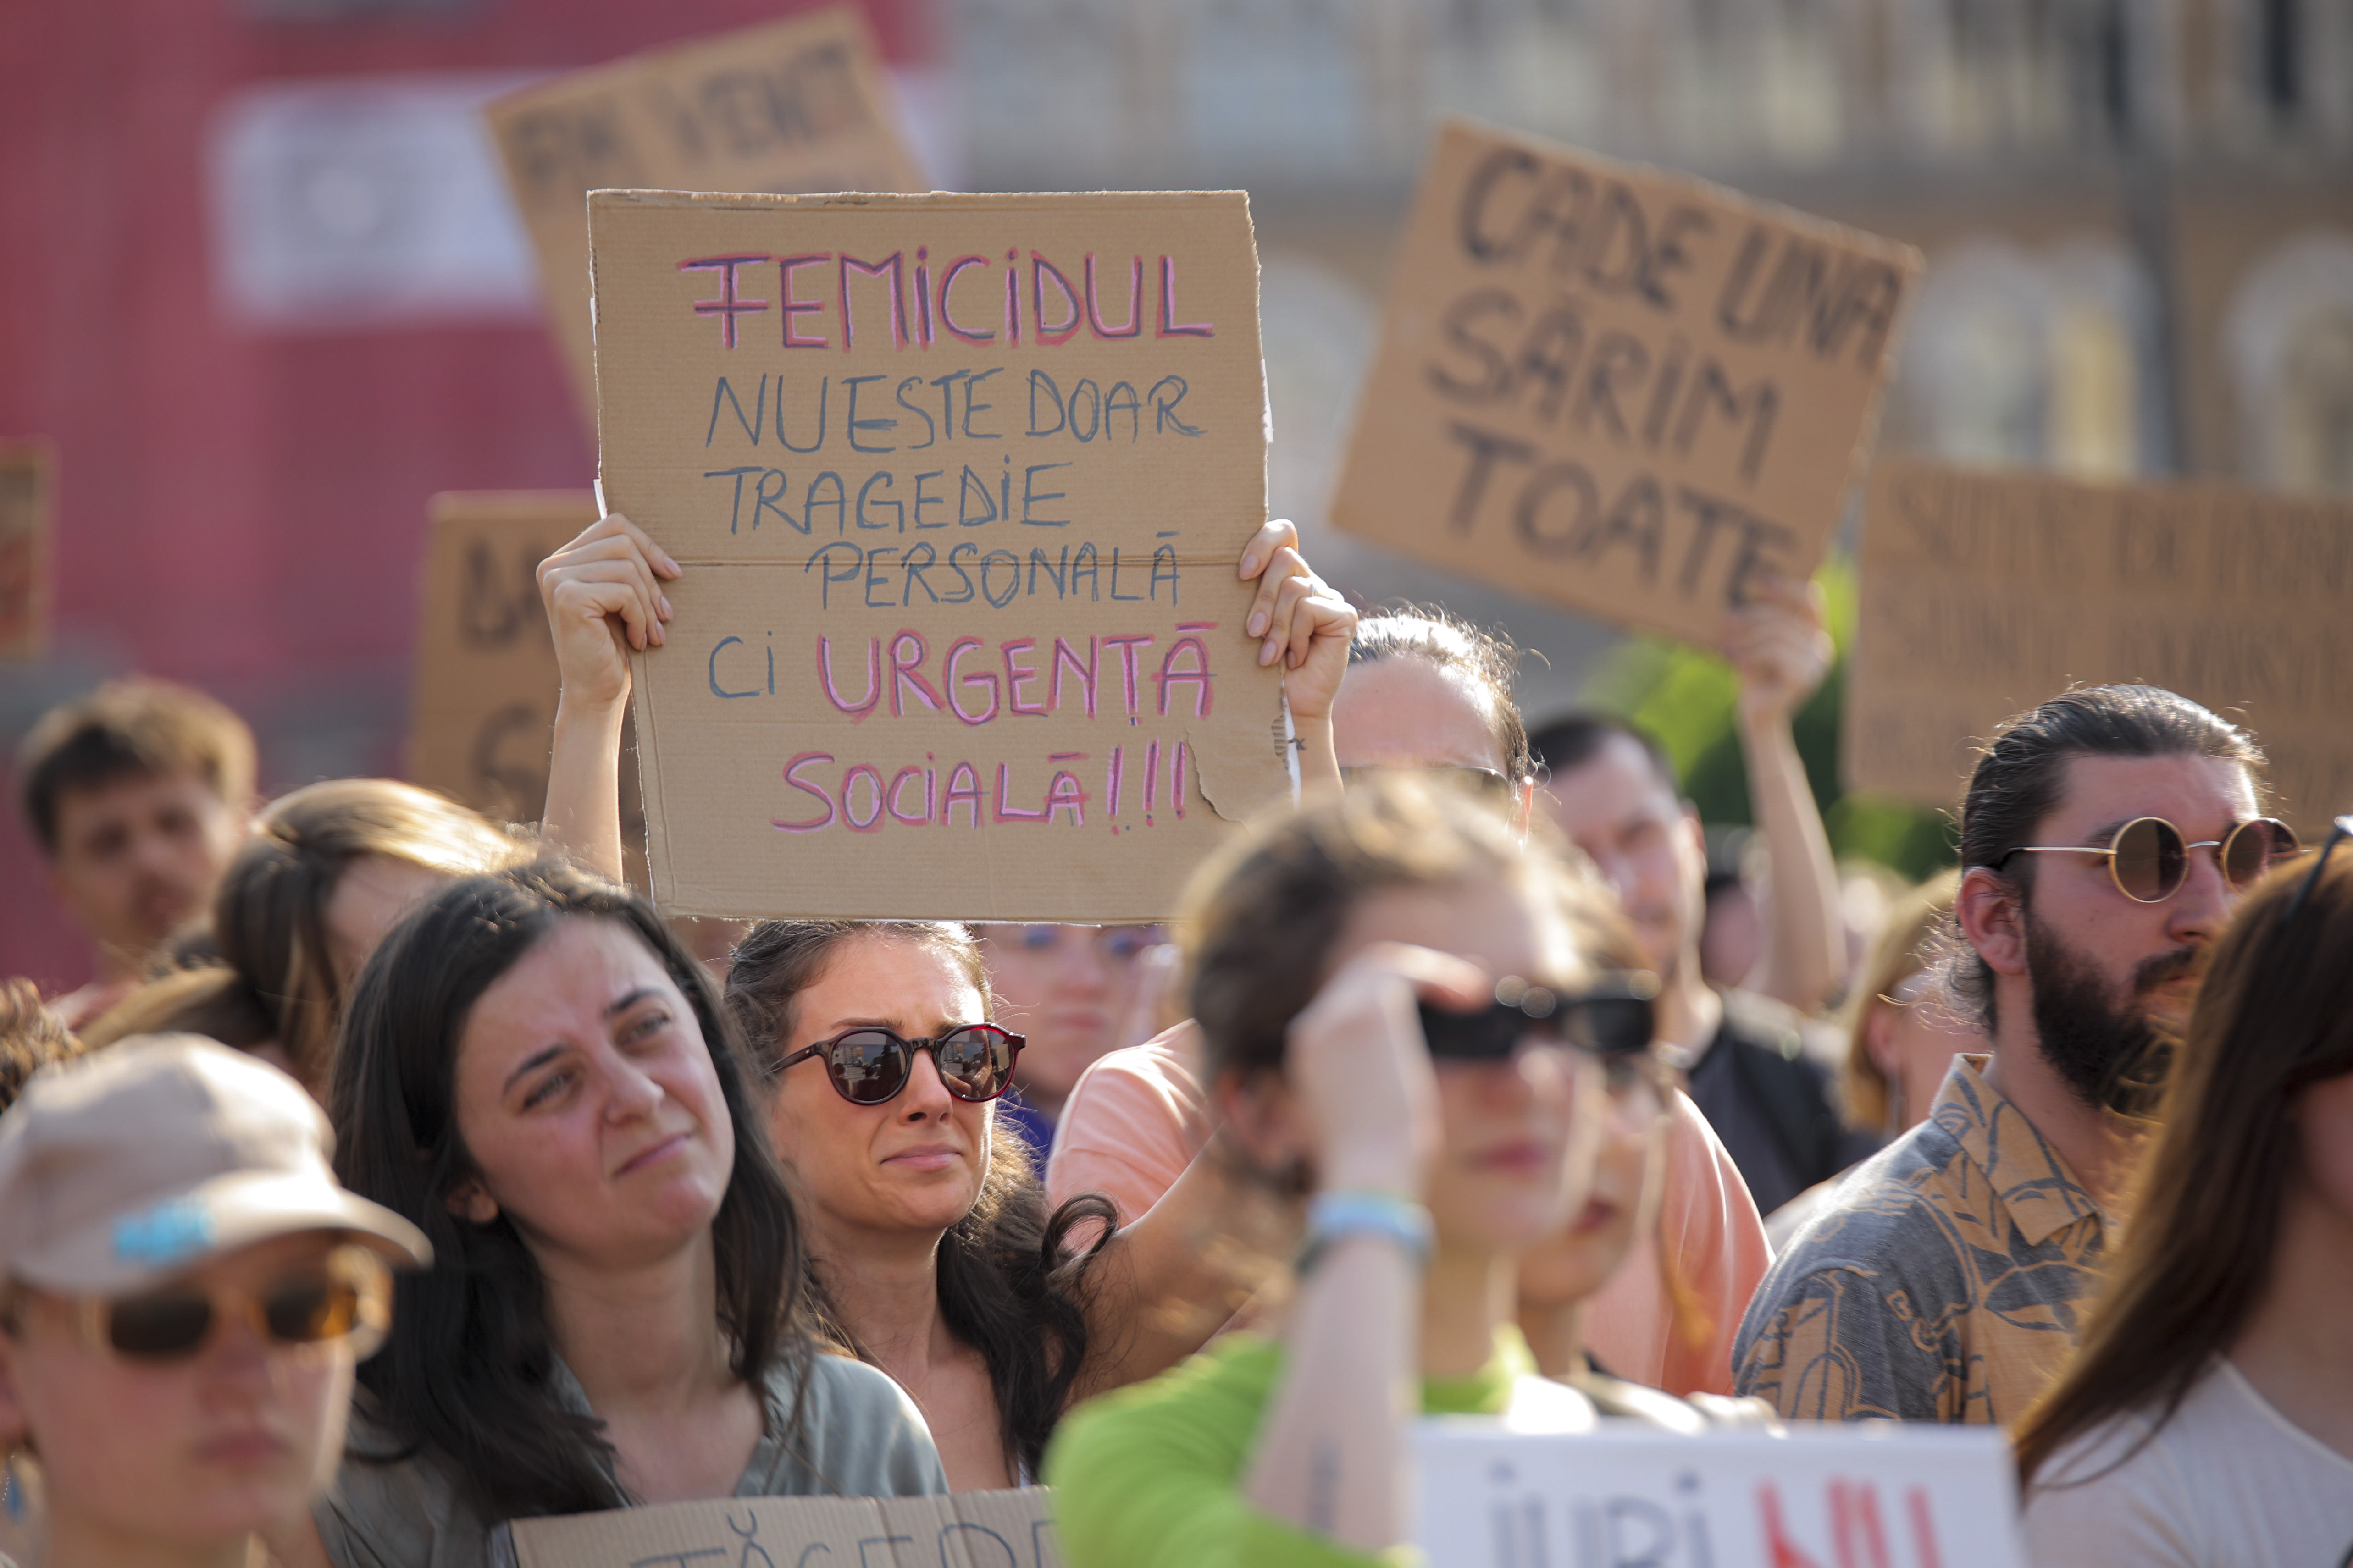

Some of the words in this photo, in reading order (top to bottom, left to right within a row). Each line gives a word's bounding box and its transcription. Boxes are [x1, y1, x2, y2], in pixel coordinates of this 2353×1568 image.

[1456, 145, 1716, 314] CADE
[1717, 225, 1904, 372] UNA
[705, 371, 828, 454] NU
[839, 367, 1005, 454] ESTE
[1024, 369, 1209, 444] DOAR
[1445, 414, 1802, 611] TOATE
